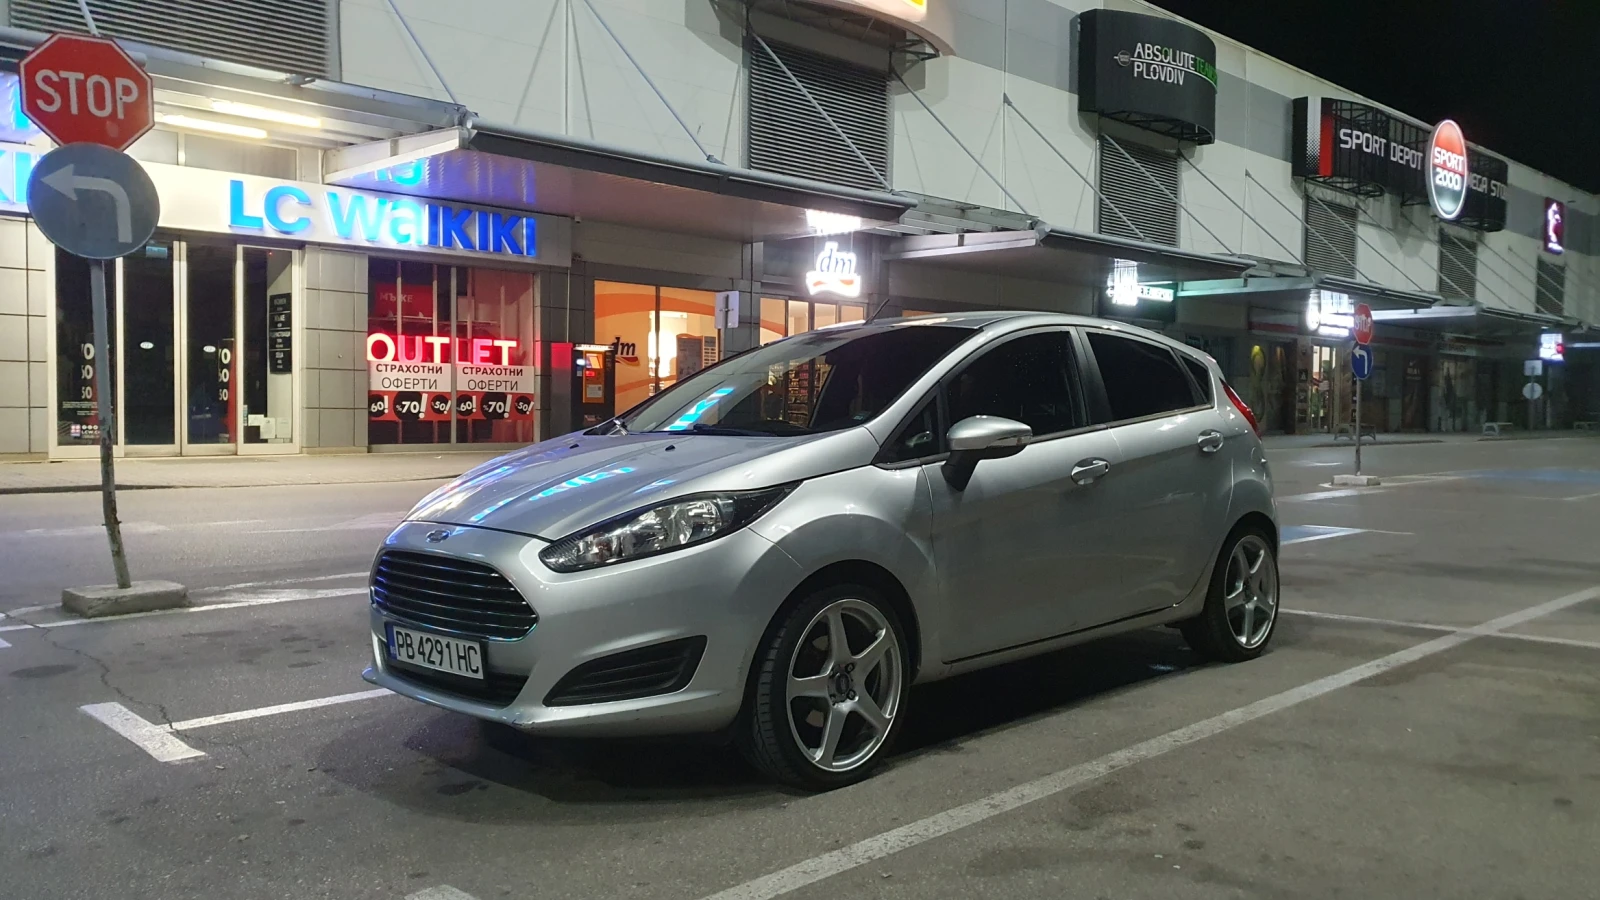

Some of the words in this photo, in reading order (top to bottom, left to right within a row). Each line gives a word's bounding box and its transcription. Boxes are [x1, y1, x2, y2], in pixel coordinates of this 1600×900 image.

[1134, 43, 1195, 71] ABSOLUTE
[1134, 62, 1185, 86] PLOVDIV
[35, 69, 138, 119] STOP
[1340, 128, 1387, 157] SPORT
[1390, 141, 1423, 171] DEPOT
[1434, 146, 1464, 172] SPORT
[1435, 167, 1462, 191] 2000
[229, 179, 311, 235] LC
[820, 248, 852, 274] dm
[367, 333, 517, 366] OUTLET
[376, 363, 443, 375] СТРАХОТНИ
[462, 367, 523, 377] СТРАХОТНИ
[381, 377, 438, 390] ОФЕРТИ
[468, 379, 518, 391] ОФЕРТИ
[396, 630, 414, 660] PB
[418, 635, 453, 669] 4291
[456, 643, 479, 674] HC
